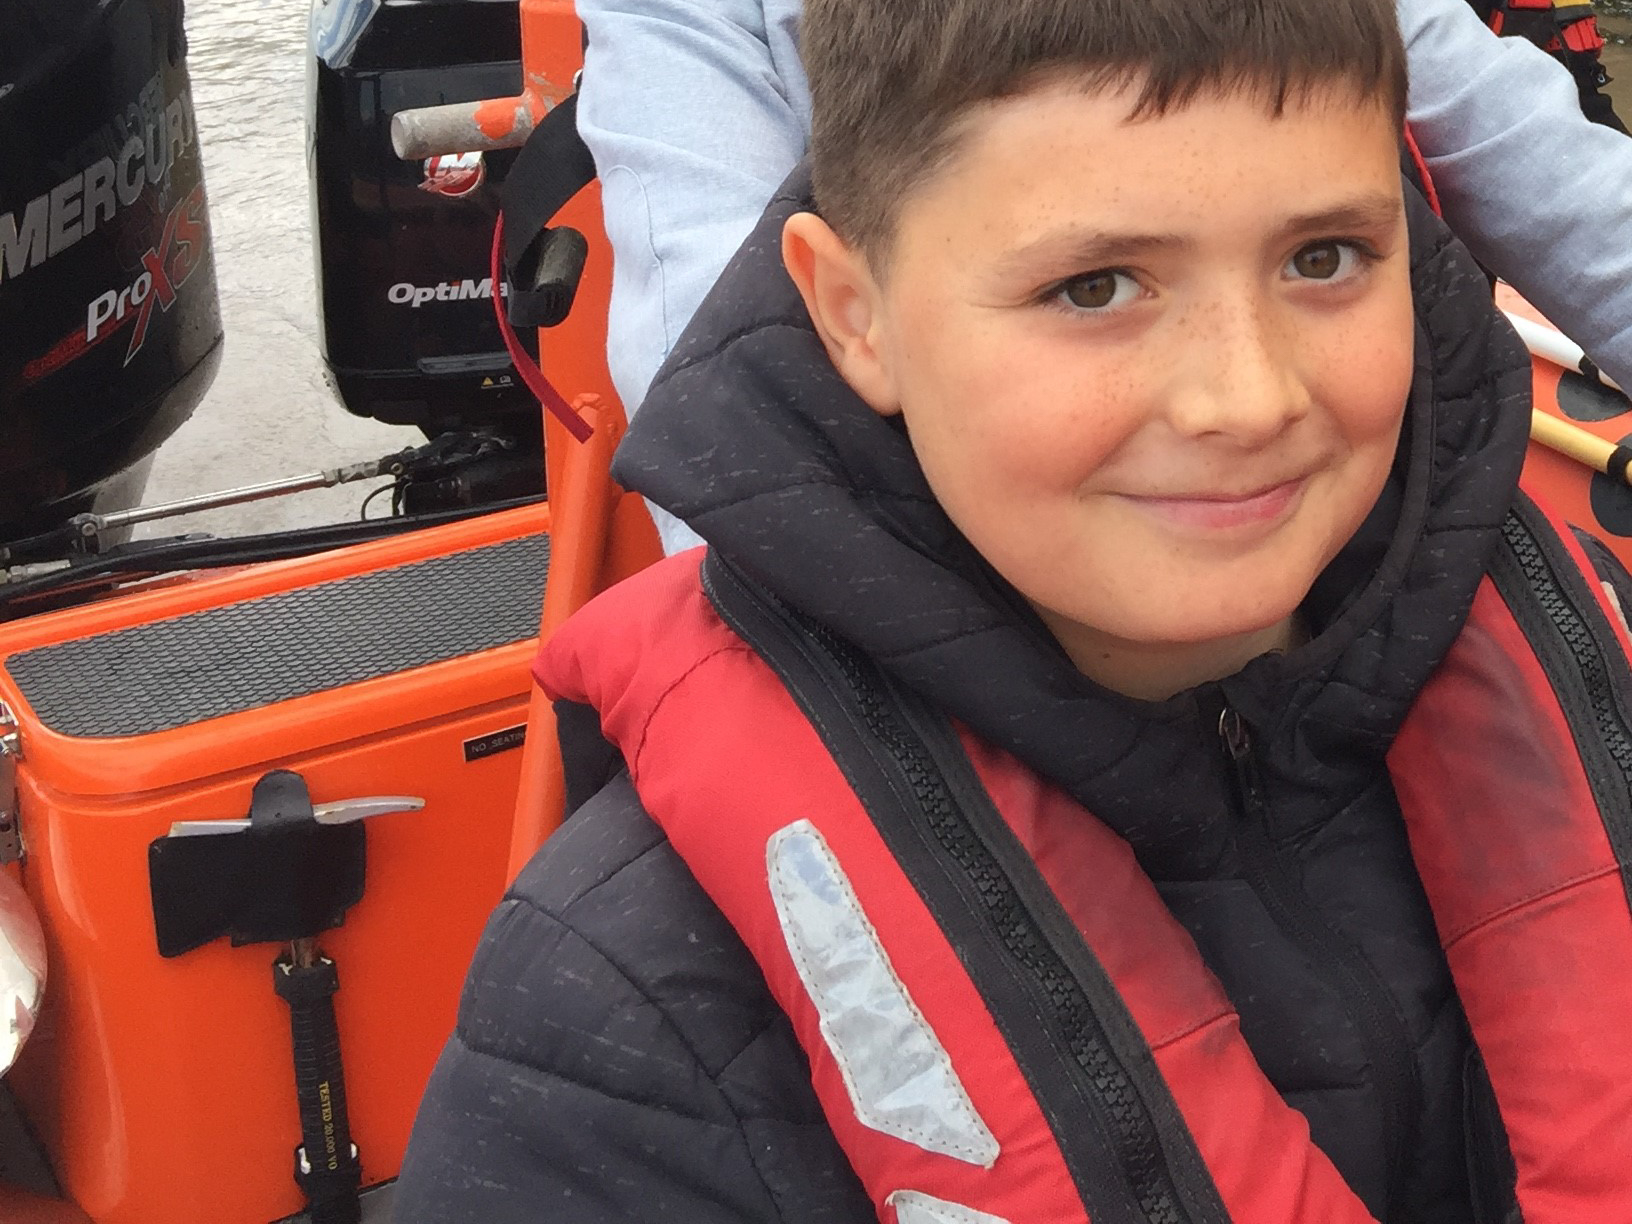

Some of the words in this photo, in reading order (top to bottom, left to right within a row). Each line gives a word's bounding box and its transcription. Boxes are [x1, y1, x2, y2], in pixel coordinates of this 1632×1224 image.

[387, 277, 509, 308] OptiMa
[471, 742, 487, 753] NO
[491, 731, 525, 748] SEATIN
[319, 1080, 332, 1122] TESTED
